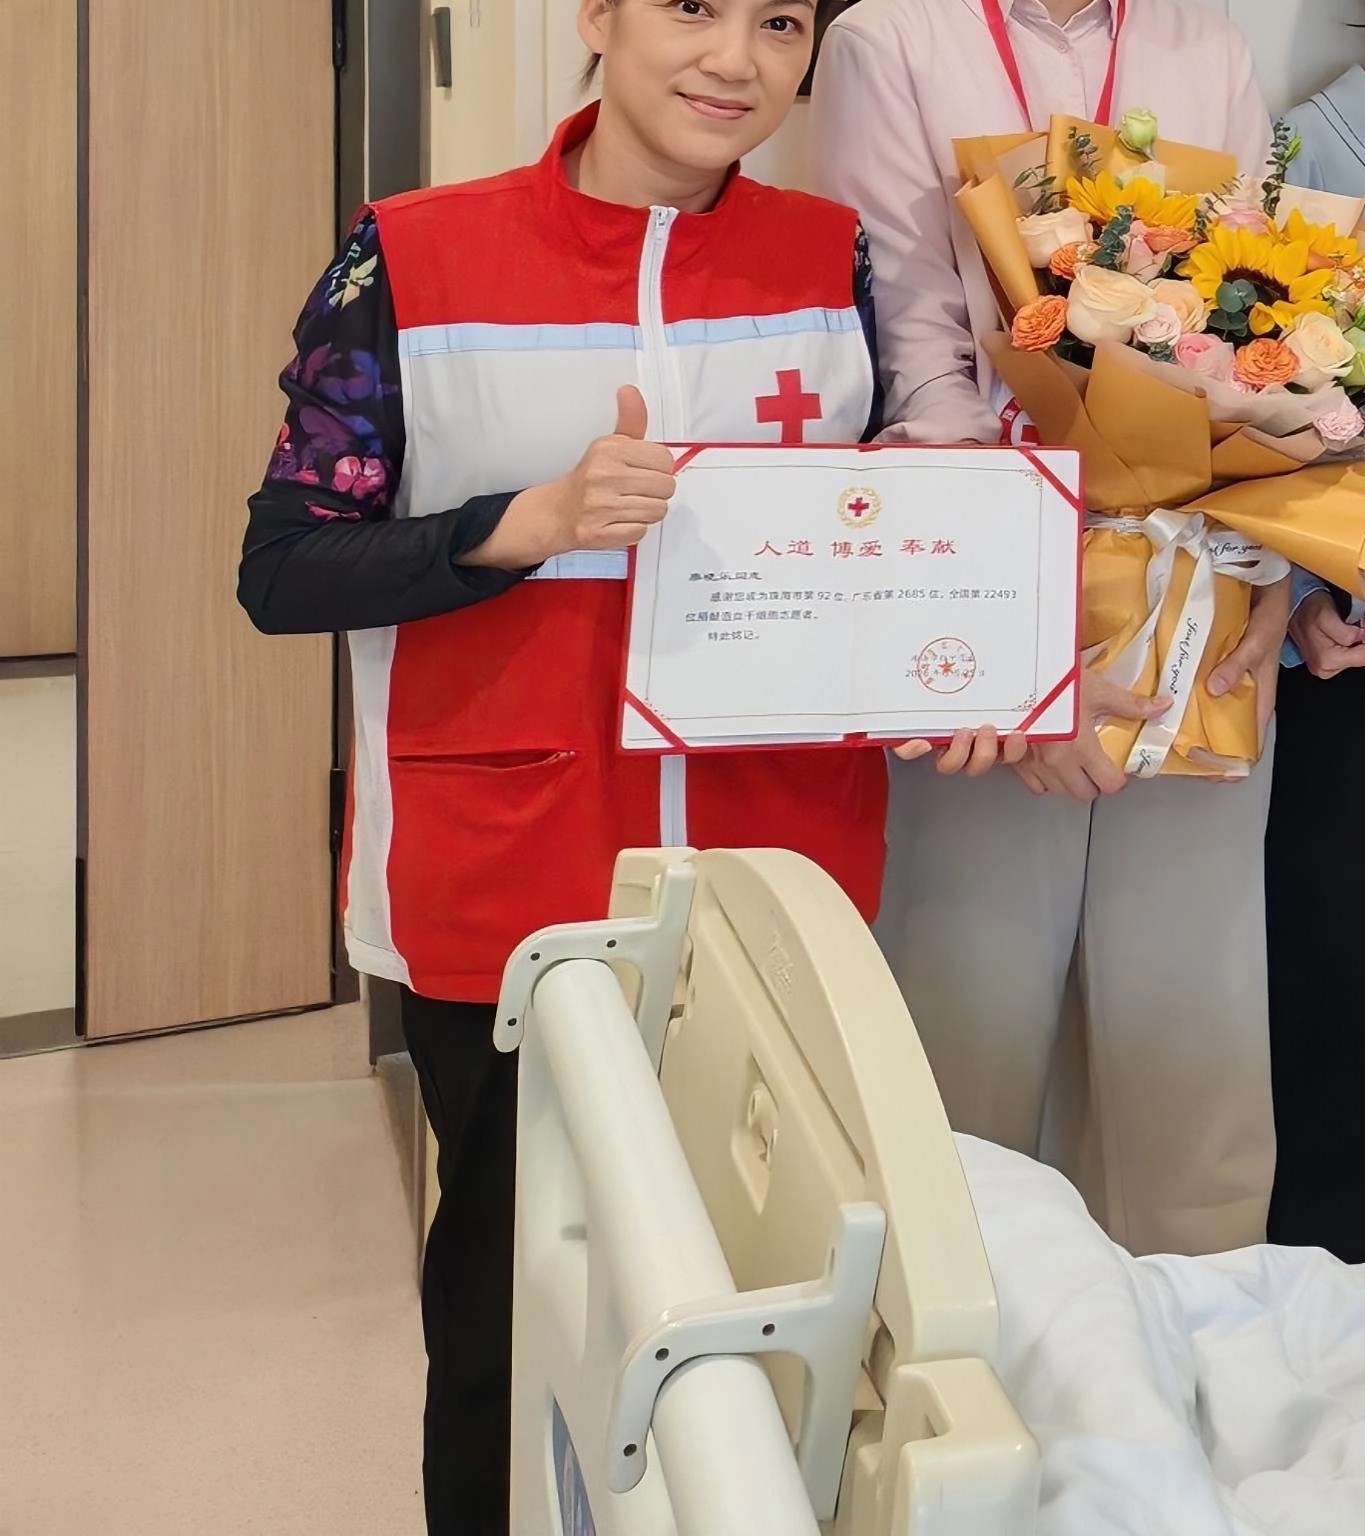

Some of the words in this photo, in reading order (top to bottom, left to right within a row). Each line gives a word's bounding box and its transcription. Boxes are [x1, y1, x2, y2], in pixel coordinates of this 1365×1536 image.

[754, 539, 815, 557] 人道
[830, 539, 883, 559] 博爱
[900, 538, 957, 556] 奉献
[816, 591, 831, 602] 92
